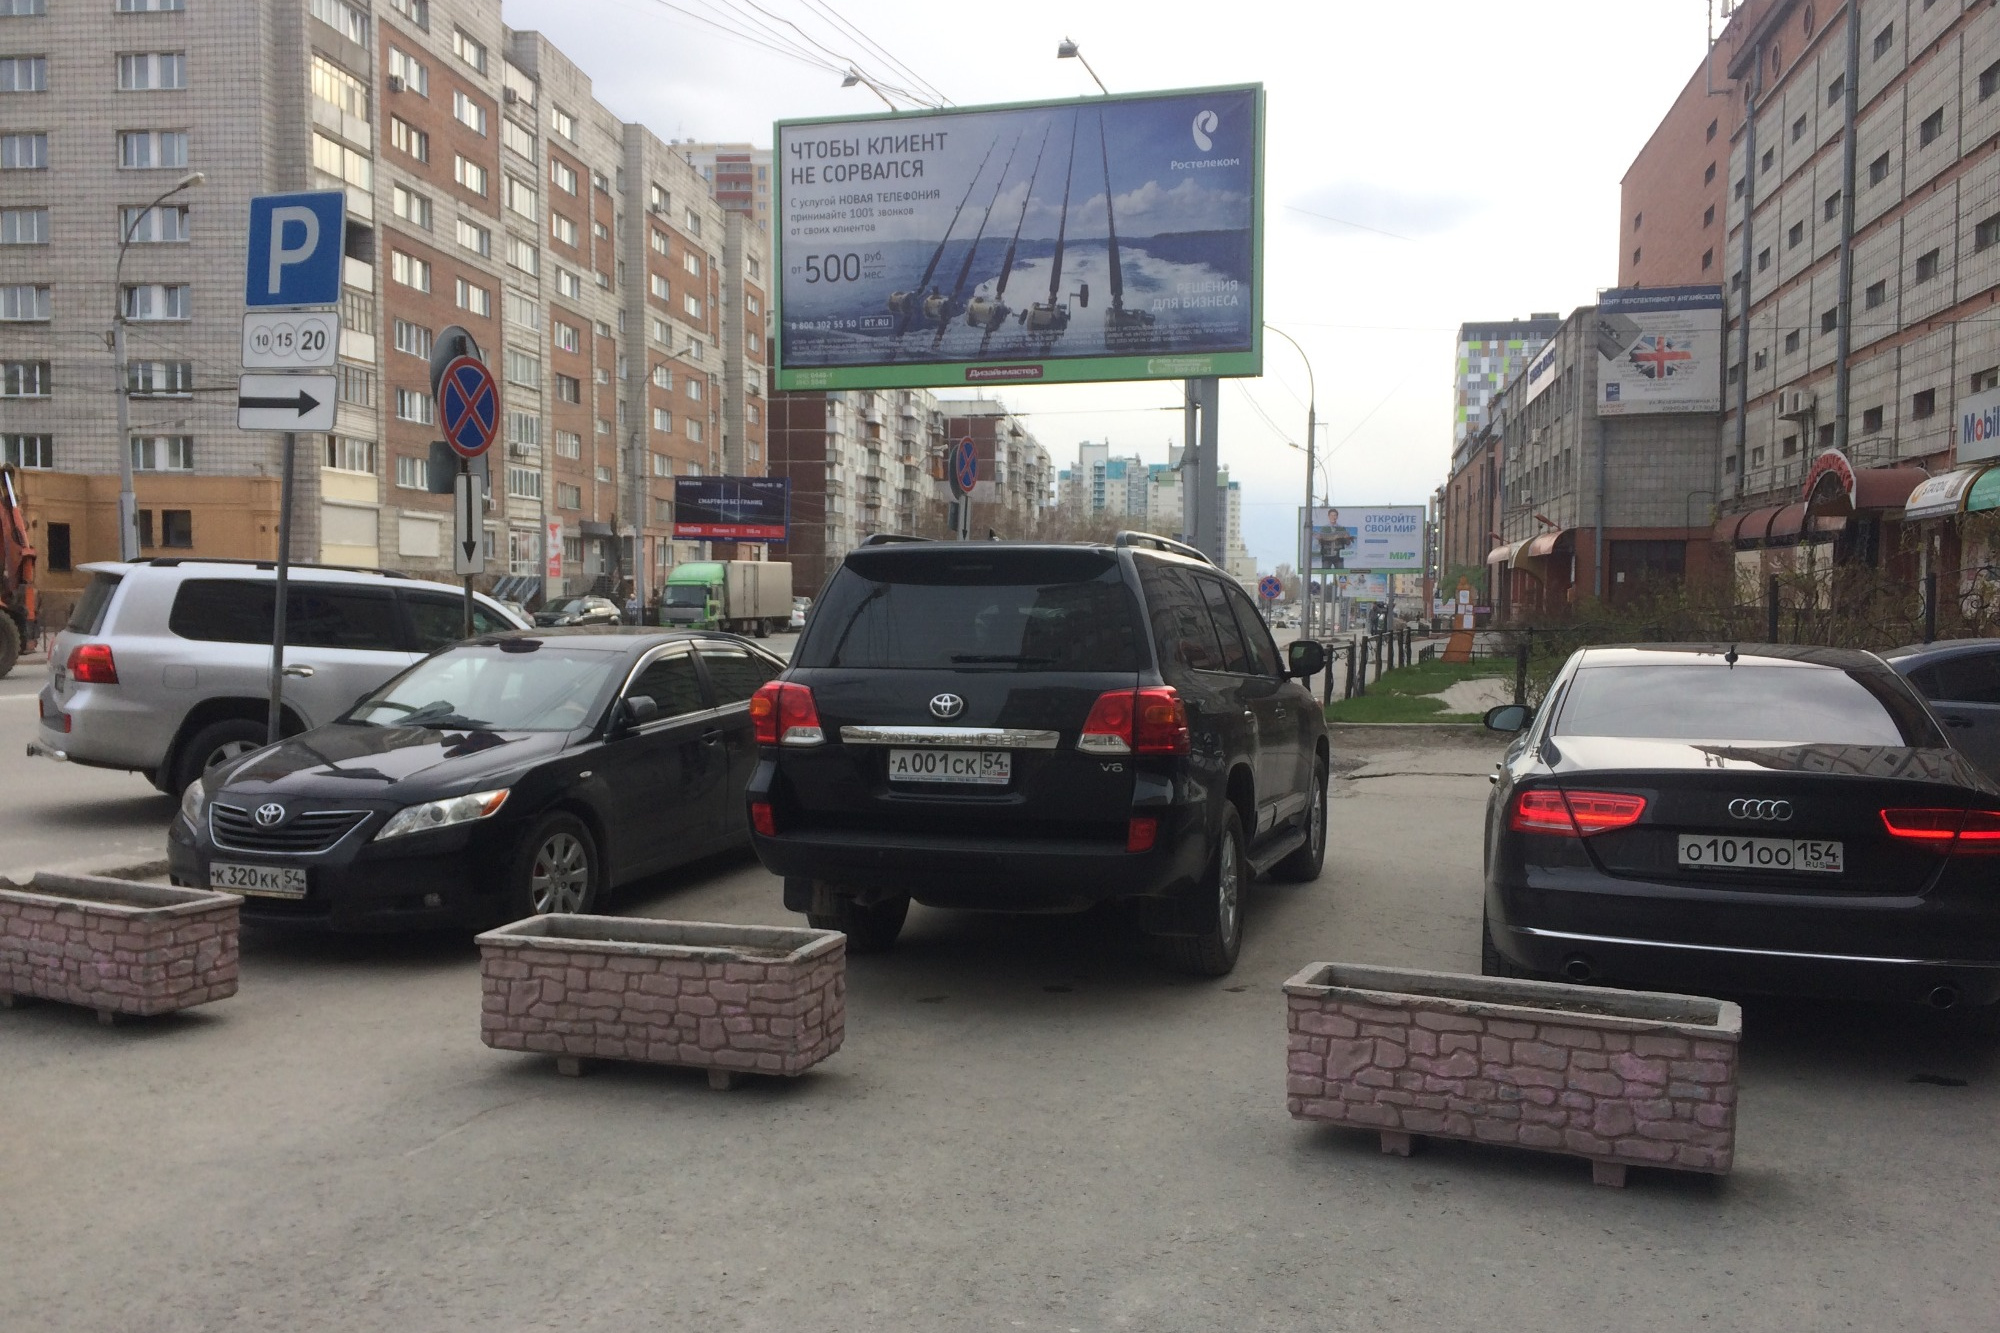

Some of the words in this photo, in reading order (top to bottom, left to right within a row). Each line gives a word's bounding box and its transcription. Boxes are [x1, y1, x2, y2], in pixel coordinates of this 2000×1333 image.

[791, 138, 859, 160] ЧТОБЫ
[868, 132, 948, 155] КЛИЕНТ
[1170, 158, 1239, 170] Ростелеком
[791, 166, 816, 184] НЕ
[823, 160, 923, 183] СОРВАЛСЯ
[791, 197, 797, 208] С
[800, 195, 836, 210] услугой
[839, 193, 873, 205] НОВАЯ
[877, 189, 940, 203] ТЕЛЕФОНИЯ
[791, 210, 846, 223] принимайте
[850, 207, 874, 219] 100%
[878, 206, 914, 218] звонков
[791, 227, 800, 236] от
[804, 226, 830, 235] своих
[833, 223, 875, 233] клиентов
[268, 205, 320, 294] P
[791, 266, 801, 275] от
[805, 252, 861, 284] 500
[864, 250, 884, 263] руб.
[864, 270, 884, 279] мес.
[1177, 280, 1238, 294] РЕШЕНИЯ
[1152, 298, 1179, 312] ДЛЯ
[1183, 295, 1238, 308] БИЗНЕСА
[799, 321, 814, 330] 800
[817, 321, 831, 330] 302
[864, 318, 890, 327] RT.RU
[255, 334, 269, 347] 10
[276, 333, 292, 347] 15
[301, 330, 325, 350] 20
[1963, 405, 2000, 444] Mobil
[1365, 513, 1416, 524] ОТКРОЙТЕ
[1365, 523, 1391, 532] СВОЙ
[1390, 552, 1416, 560] МИР
[868, 731, 918, 742] LAND
[932, 732, 1028, 746] CRUISER
[983, 753, 1004, 770] 54
[1797, 842, 1837, 862] 154
[1805, 861, 1826, 869] RUS
[284, 870, 301, 885] 54
